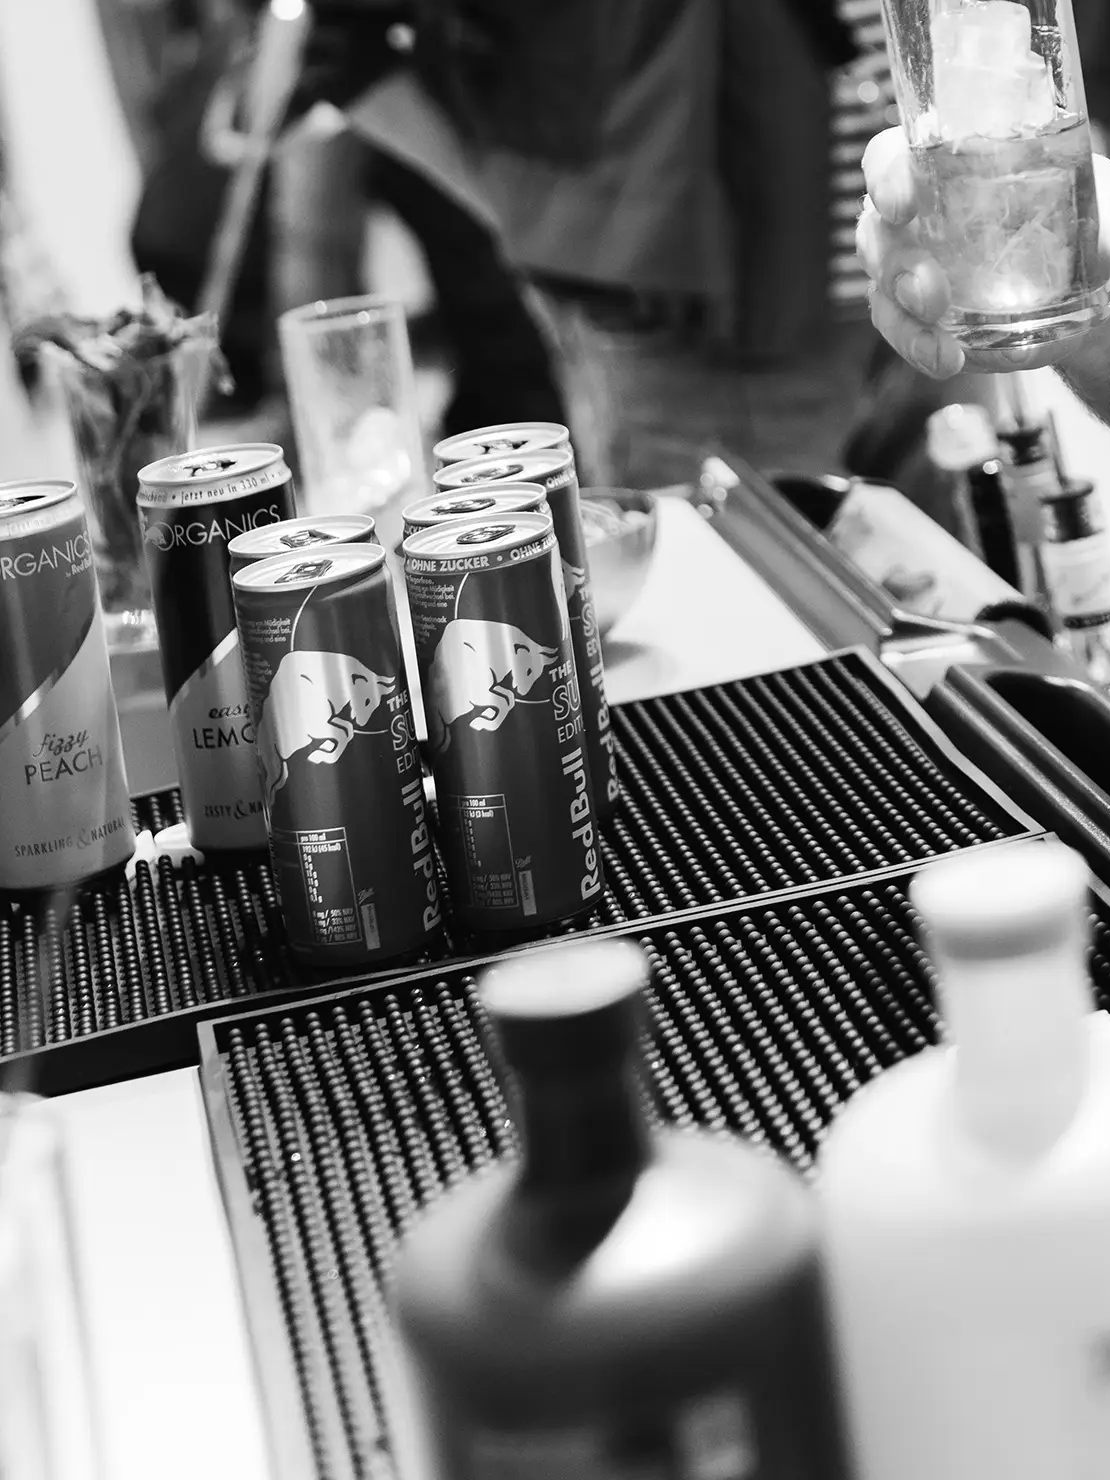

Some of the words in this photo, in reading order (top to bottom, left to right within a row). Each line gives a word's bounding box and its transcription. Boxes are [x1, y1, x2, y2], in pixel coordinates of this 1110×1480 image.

[181, 491, 203, 505] jetzt
[207, 487, 224, 498] neu
[227, 484, 238, 493] in
[240, 477, 258, 490] 330
[260, 473, 270, 484] ml
[411, 559, 437, 572] OHNE
[439, 556, 490, 572] ZUCKER
[510, 541, 542, 561] OHNE
[549, 659, 572, 683] THE
[387, 689, 409, 713] THE
[32, 729, 89, 758] fizzy
[24, 745, 104, 786] PEACH
[600, 730, 621, 802] Red
[560, 747, 591, 824] Bull
[401, 778, 430, 855] Bull
[14, 836, 73, 857] SPARKLING
[76, 828, 92, 850] &
[308, 833, 319, 842] 100
[572, 820, 601, 901] Red
[413, 852, 442, 932] Red
